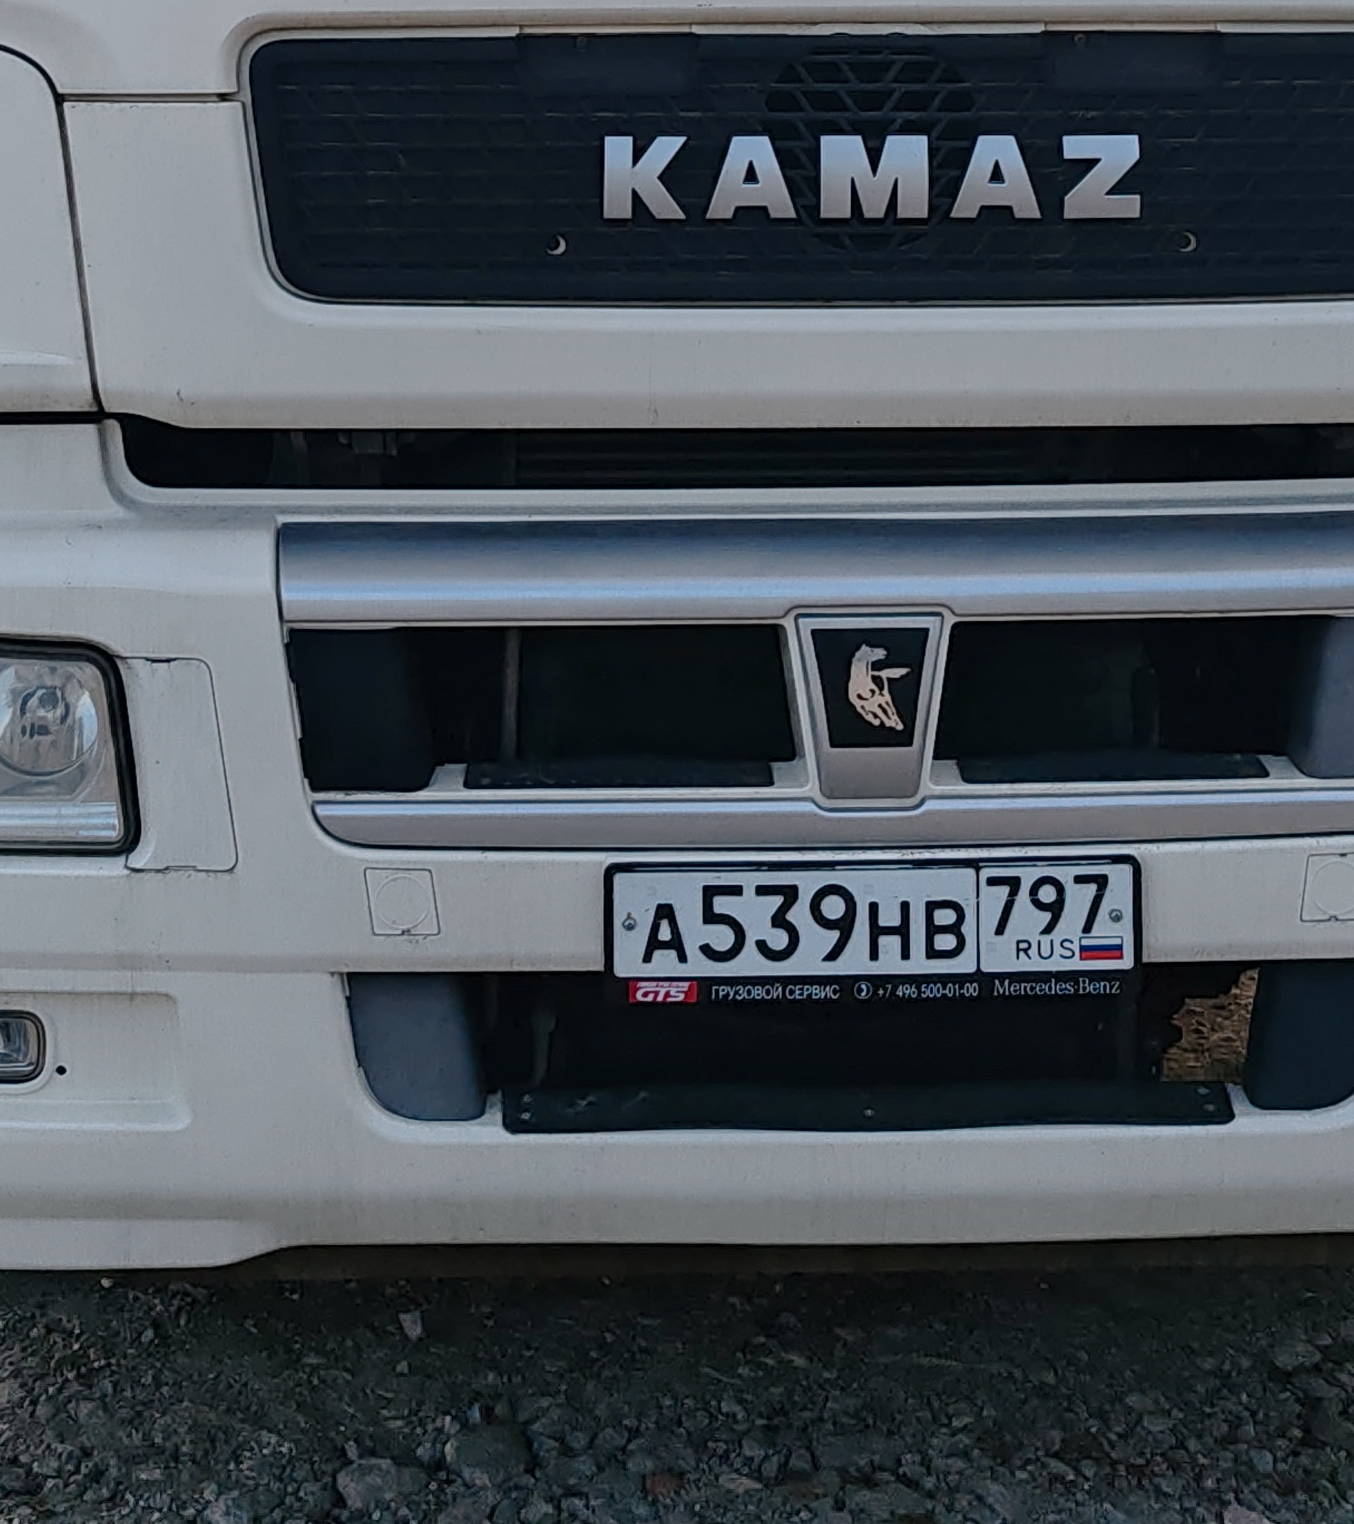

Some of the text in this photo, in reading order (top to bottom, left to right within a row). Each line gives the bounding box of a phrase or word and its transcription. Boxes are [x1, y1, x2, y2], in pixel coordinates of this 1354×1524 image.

[602, 134, 1142, 219] KAMAZ
[986, 874, 1110, 937] 797
[1016, 939, 1075, 961] RUS
[636, 987, 688, 1002] GTS
[711, 982, 841, 1000] ГРУЗОВОЙ СЕРВИС
[876, 984, 892, 998] +7
[920, 982, 980, 998] 500-01-00
